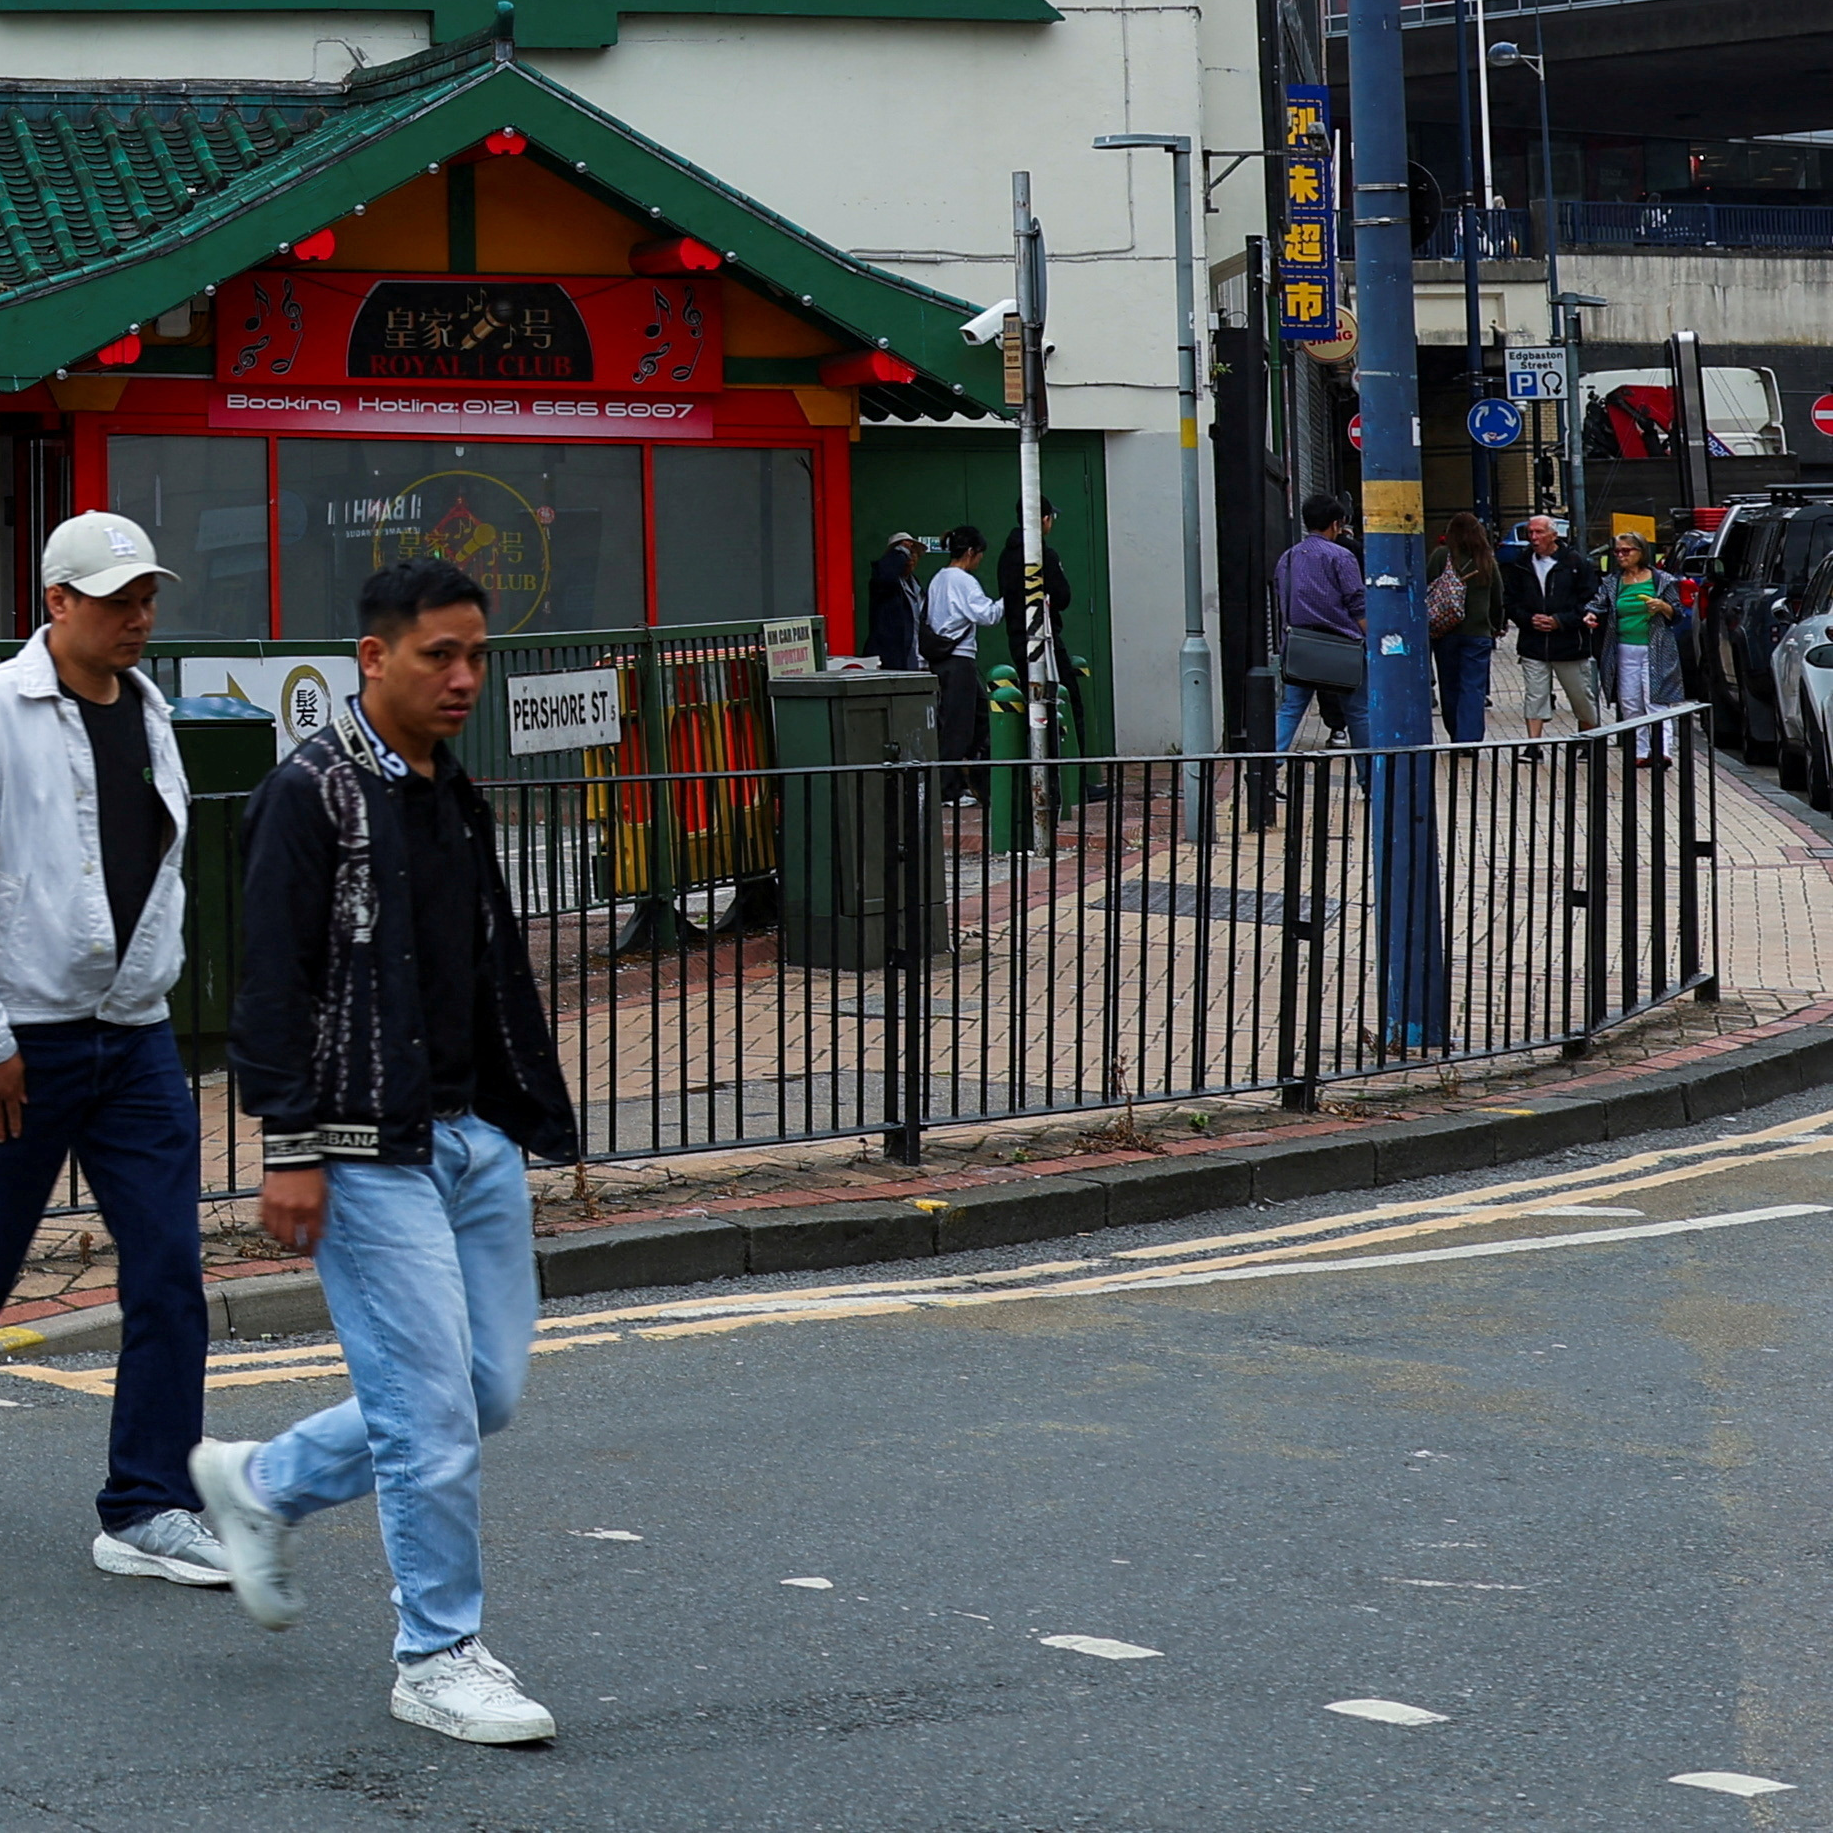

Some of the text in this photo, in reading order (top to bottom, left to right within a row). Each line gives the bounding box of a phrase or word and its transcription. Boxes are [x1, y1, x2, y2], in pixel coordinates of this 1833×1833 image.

[369, 354, 572, 377] ROYAL CLUB
[1508, 351, 1564, 363] Edgbaston
[1520, 360, 1554, 370] Street
[227, 394, 694, 419] Booking Hotline: 0121 666 6007
[104, 527, 137, 557] LA
[481, 573, 537, 590] CLUB
[513, 690, 616, 732] PERSHORE ST 5
